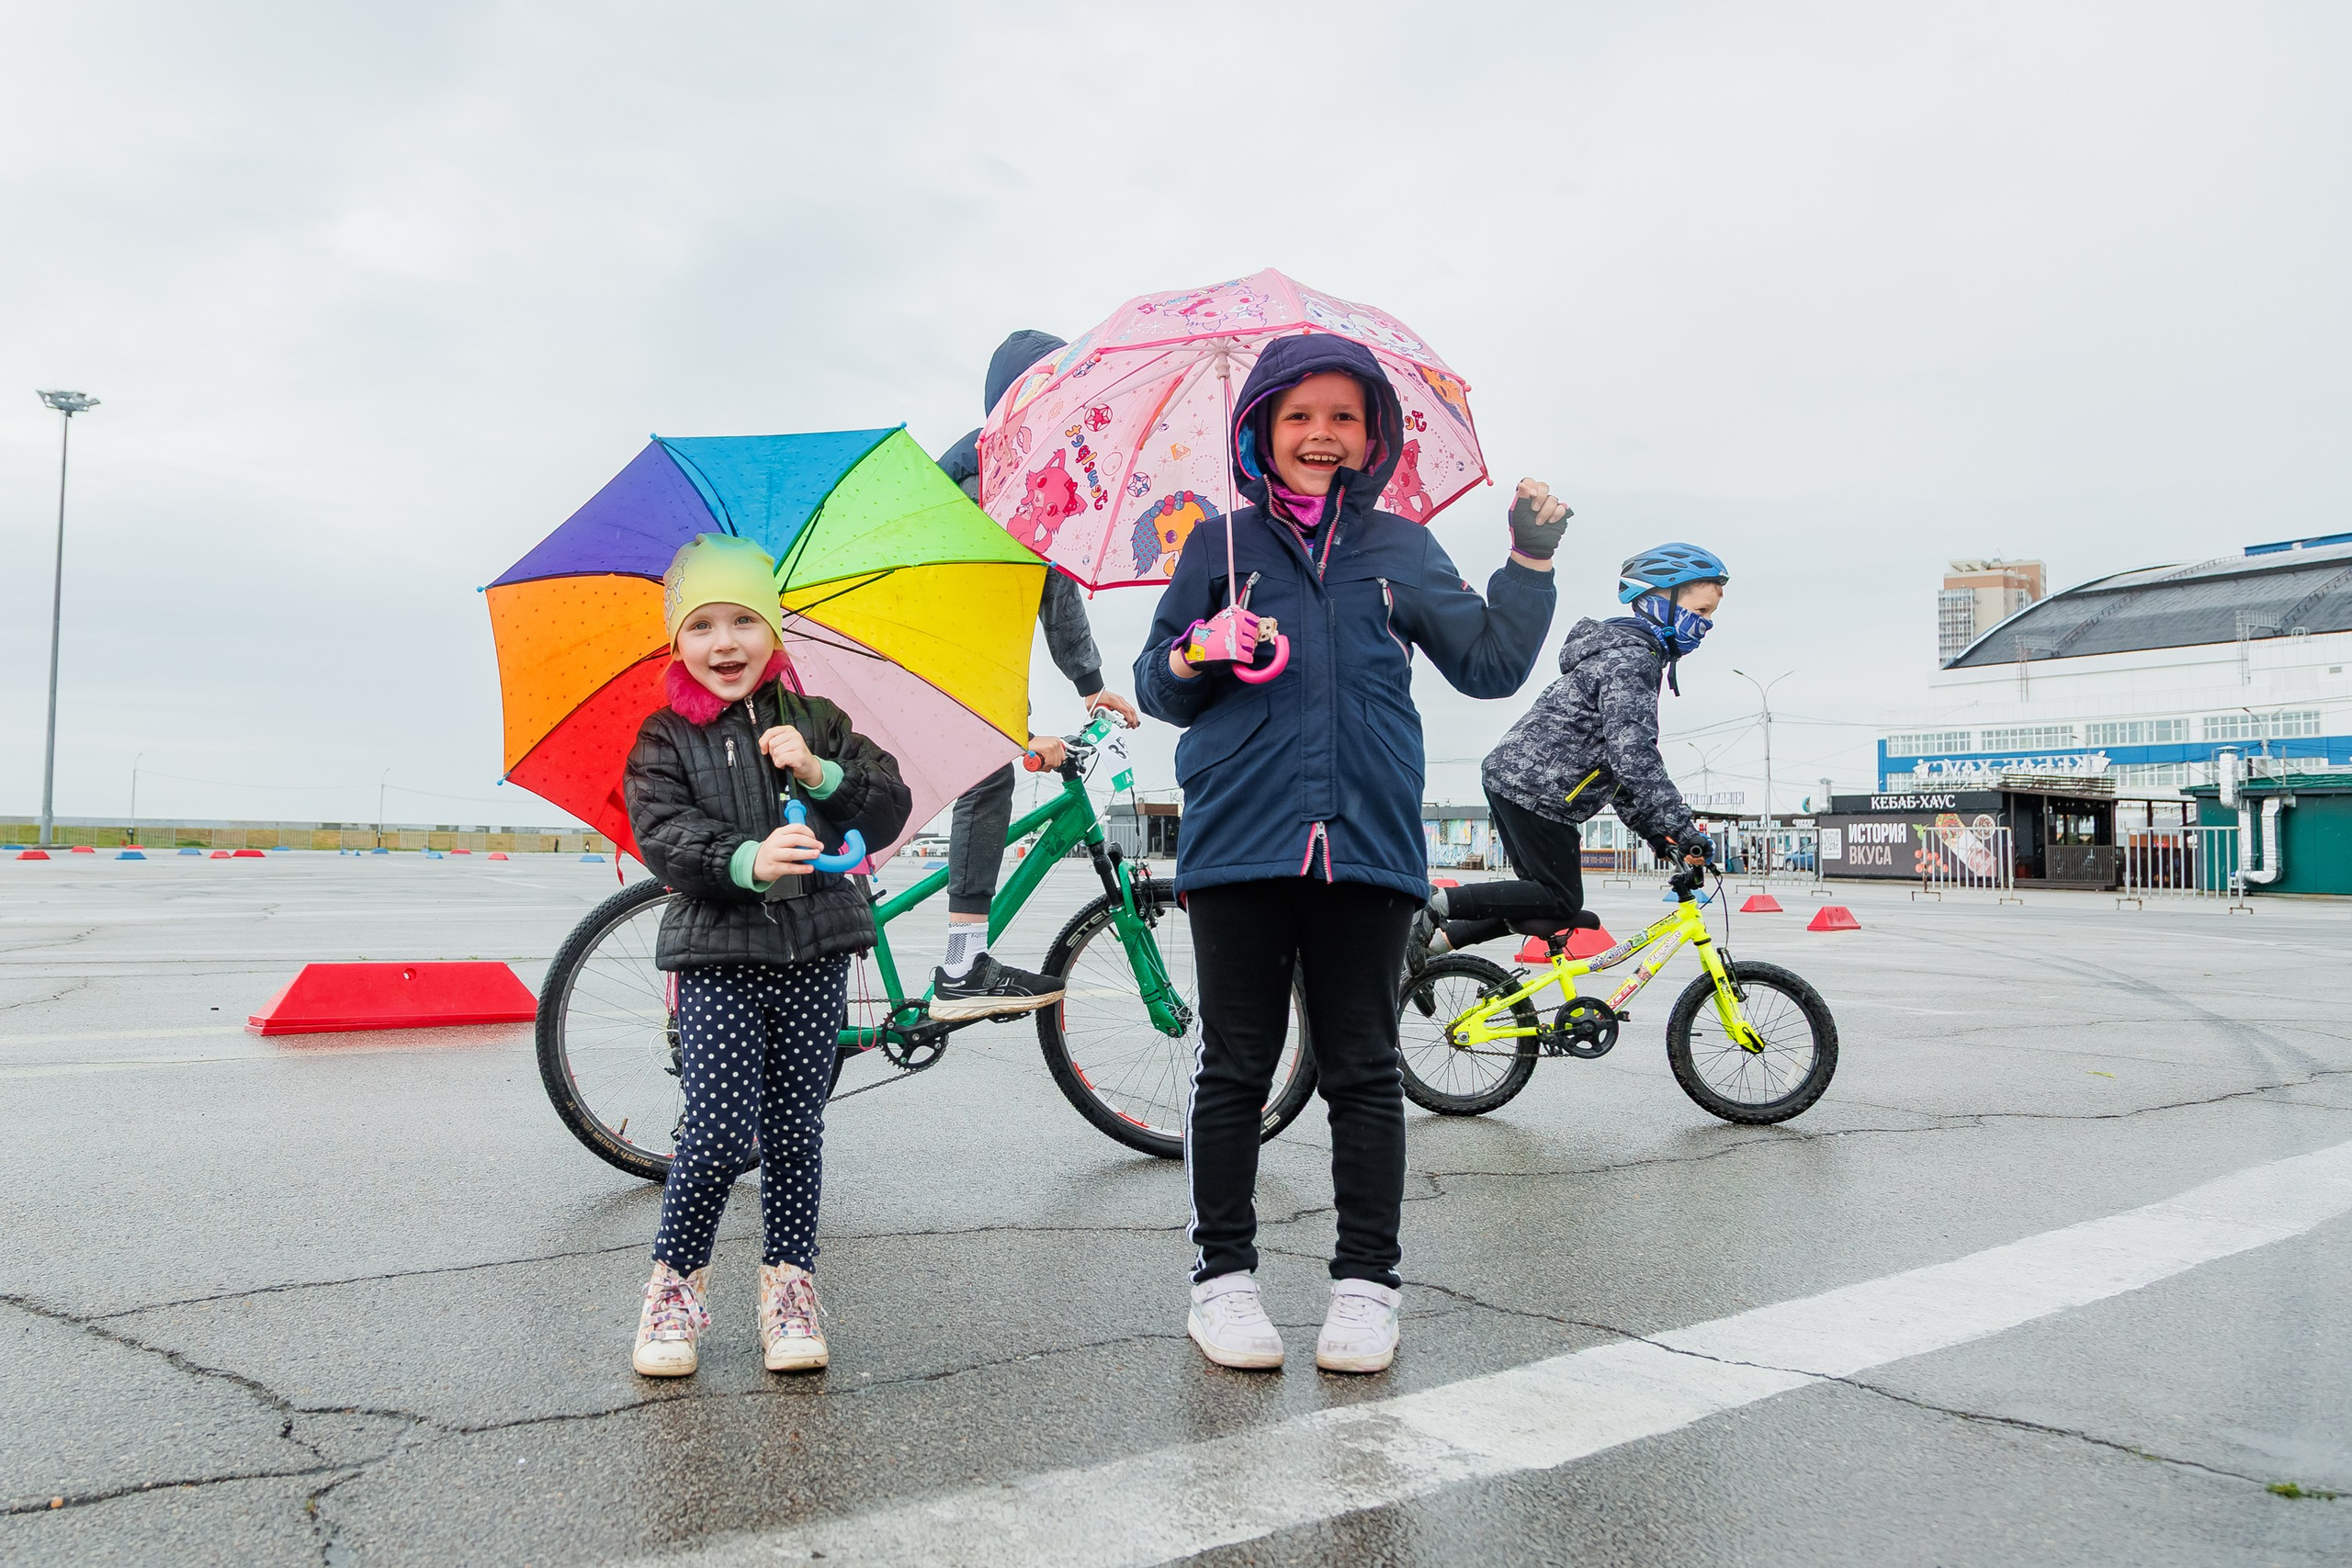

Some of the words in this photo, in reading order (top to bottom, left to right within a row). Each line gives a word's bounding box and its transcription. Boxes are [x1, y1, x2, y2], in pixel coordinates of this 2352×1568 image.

[1871, 794, 1956, 810] КЕБАБ-ХАУС
[1849, 823, 1906, 843] ИСТОРИЯ
[1849, 845, 1892, 865] ВКУСА
[1066, 909, 1111, 948] STEL
